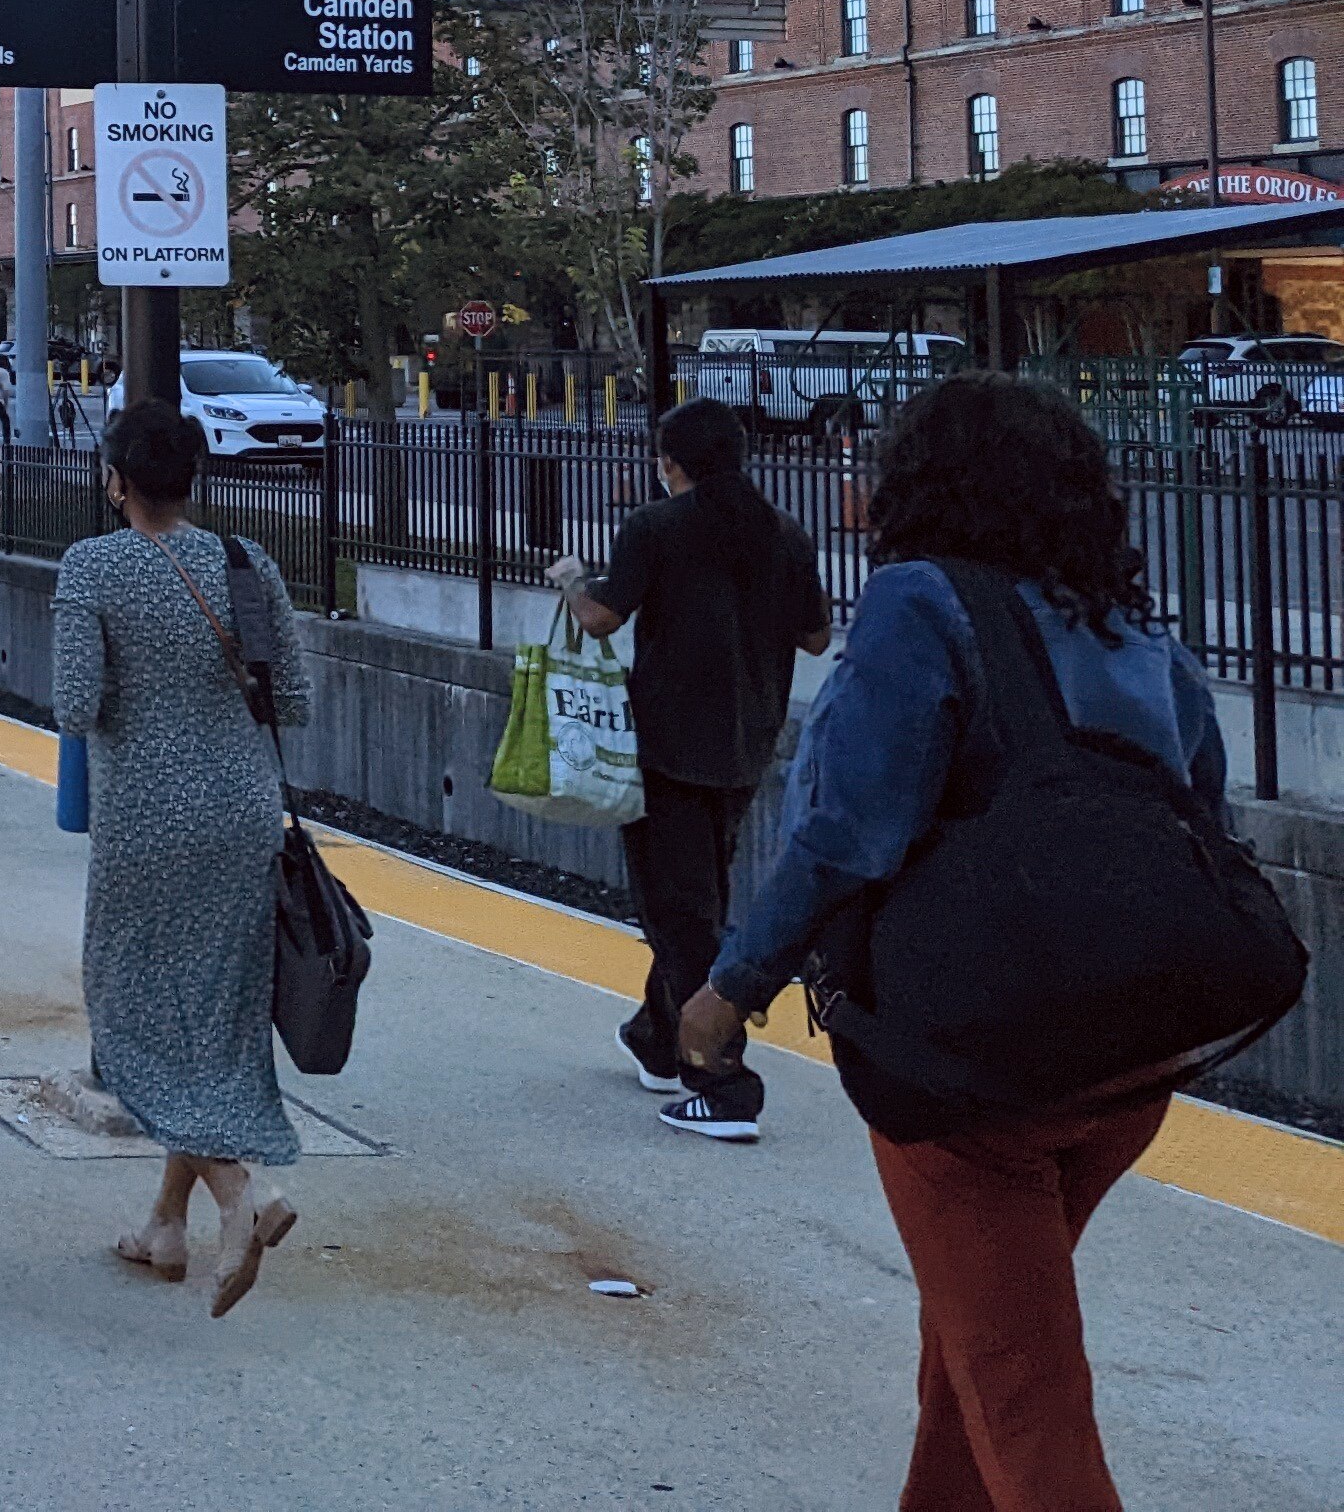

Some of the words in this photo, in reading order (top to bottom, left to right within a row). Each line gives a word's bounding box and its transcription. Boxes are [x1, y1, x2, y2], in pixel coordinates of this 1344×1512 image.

[318, 22, 413, 50] Station
[284, 52, 357, 72] Camden
[362, 54, 413, 74] Yards
[144, 101, 177, 119] NO
[107, 124, 213, 142] SMOKING
[1217, 175, 1251, 194] THE
[1255, 175, 1337, 203] ORIOLES
[102, 247, 128, 261] ON
[133, 247, 224, 262] PLATFORM
[463, 311, 492, 325] STOP
